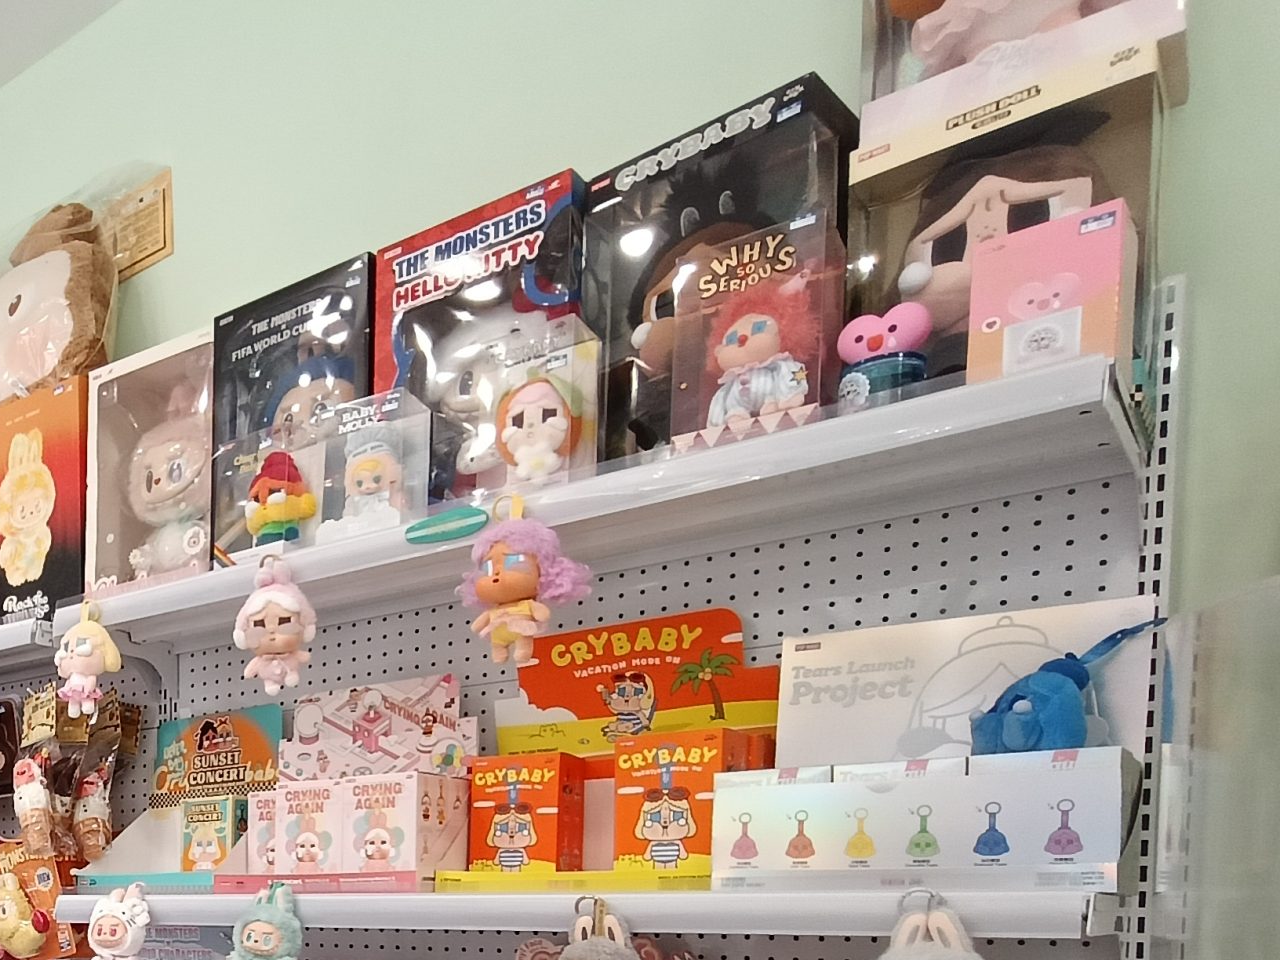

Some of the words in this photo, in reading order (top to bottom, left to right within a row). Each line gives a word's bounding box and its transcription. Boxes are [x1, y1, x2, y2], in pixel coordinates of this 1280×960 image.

[615, 97, 775, 191] CRYBABY
[396, 249, 429, 280] THE
[434, 202, 543, 262] MONSTERS
[471, 233, 542, 277] ITTY
[710, 233, 784, 276] WHY
[698, 246, 797, 299] SERIOUS
[737, 263, 755, 277] SO
[251, 321, 269, 336] THE
[271, 297, 324, 329] MONSTER
[231, 344, 253, 362] FIFA
[254, 332, 291, 352] WORLD
[338, 414, 381, 434] MOLLY
[342, 404, 378, 422] BABY
[551, 624, 702, 666] CRYBABY
[573, 661, 627, 679] VACATION
[632, 657, 661, 667] MODE
[665, 655, 681, 665] ON
[792, 663, 843, 681] Tears
[846, 656, 916, 676] Launch
[789, 678, 915, 708] Project
[193, 750, 241, 770] SUNSET
[618, 746, 718, 769] CRYBABY
[189, 769, 247, 785] CONCERT
[474, 767, 555, 786] CRYBABY
[285, 788, 331, 802] CRYING
[353, 782, 402, 797] CRYING
[256, 799, 275, 811] CRY
[287, 801, 324, 815] AGAIN
[355, 796, 396, 811] AGAIN
